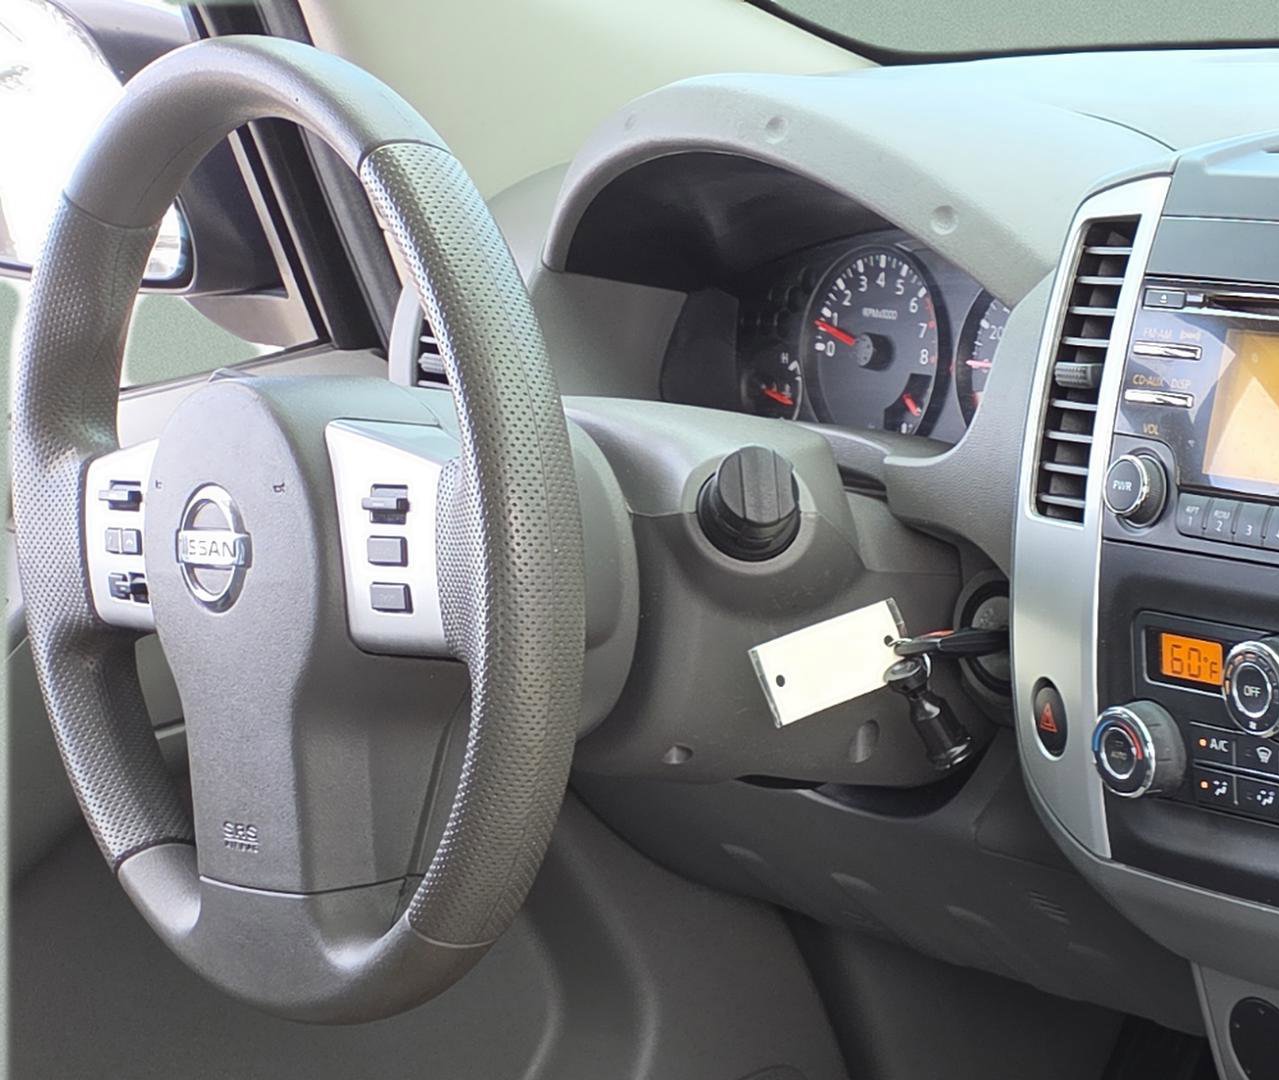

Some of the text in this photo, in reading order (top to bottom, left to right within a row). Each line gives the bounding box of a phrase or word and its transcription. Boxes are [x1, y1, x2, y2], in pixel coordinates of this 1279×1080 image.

[858, 276, 868, 292] 3
[876, 272, 886, 288] 4
[895, 279, 905, 295] 5
[842, 290, 852, 306] 2
[909, 297, 918, 313] 6
[918, 323, 928, 338] 7
[826, 341, 835, 357] 0
[920, 349, 929, 364] 8
[1112, 480, 1133, 491] PWR
[1215, 520, 1224, 532] 2
[1245, 525, 1253, 536] 3
[1243, 686, 1261, 698] OFF
[1209, 739, 1230, 753] A/C
